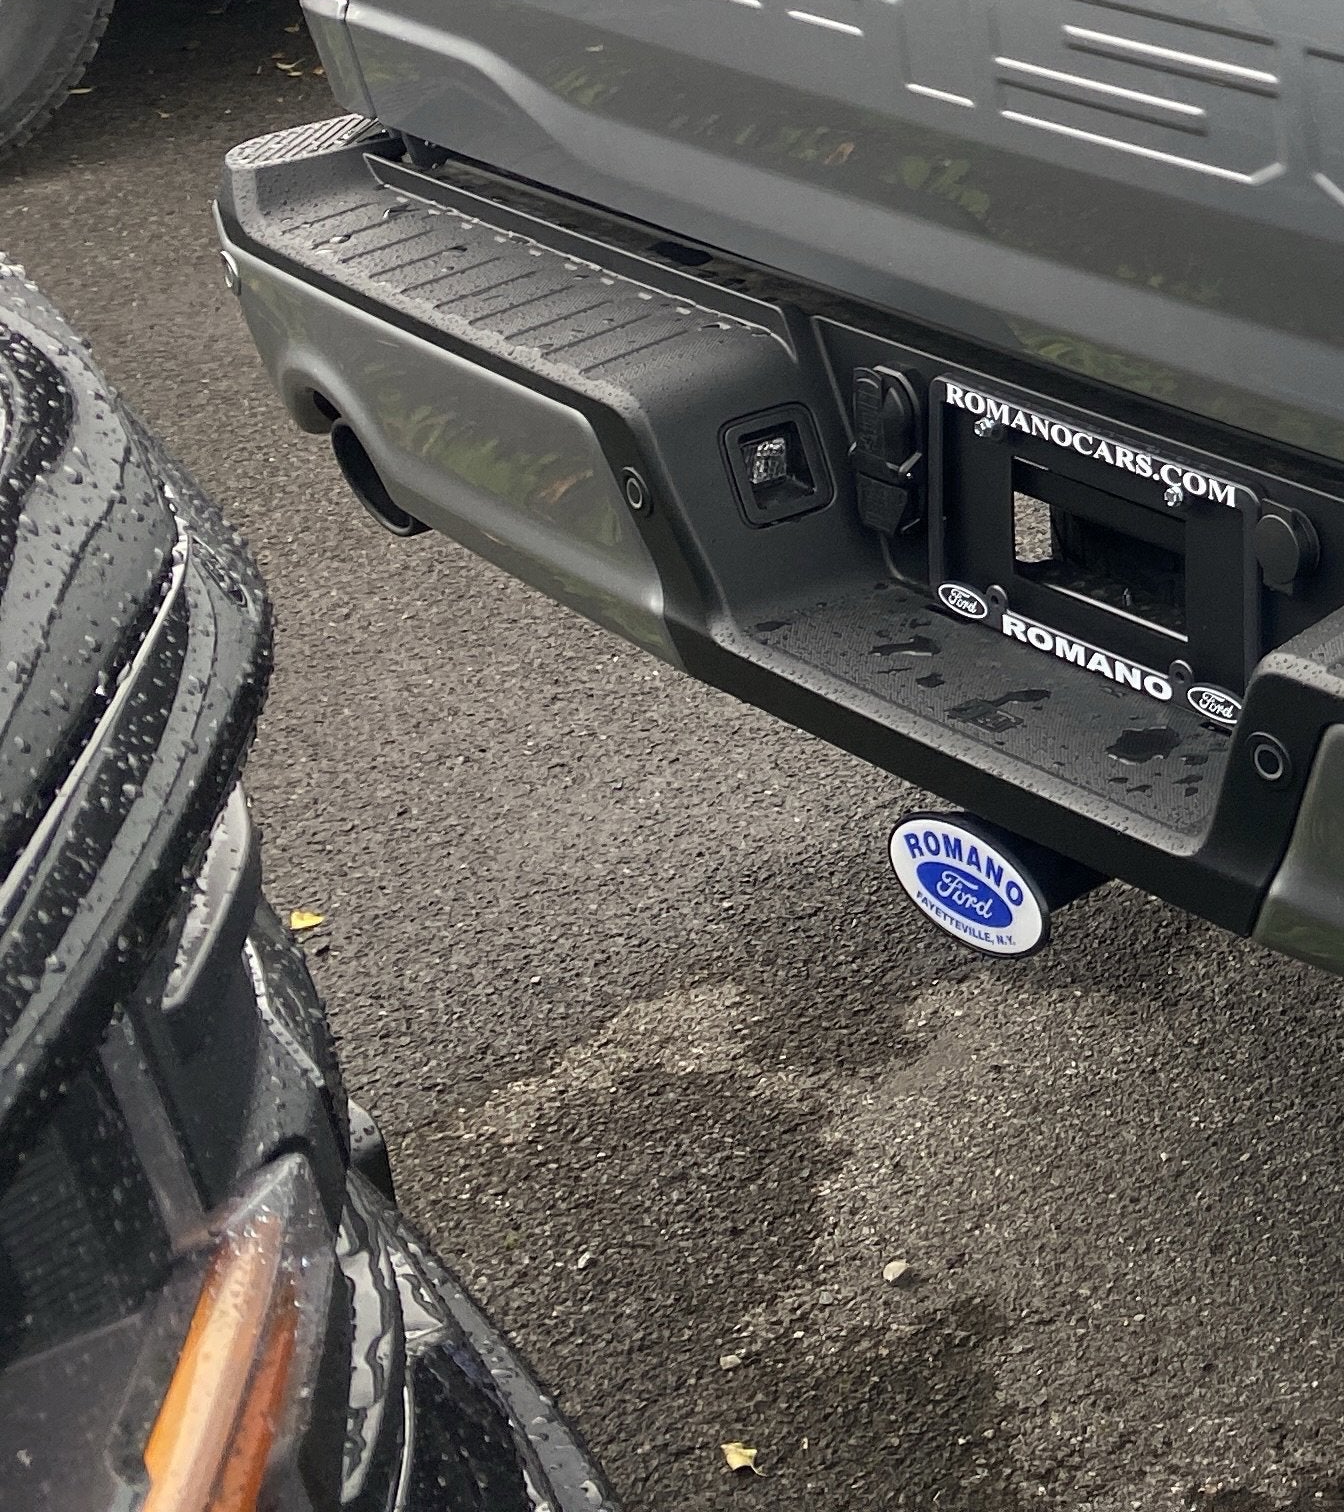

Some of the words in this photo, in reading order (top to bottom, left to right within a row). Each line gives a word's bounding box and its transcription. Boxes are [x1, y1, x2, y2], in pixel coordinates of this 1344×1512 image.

[945, 382, 1236, 508] ROMANOCARS.COM
[948, 588, 978, 614] Ford
[1001, 613, 1174, 702] ROMANO
[1198, 691, 1233, 719] Ford
[903, 830, 1025, 908] ROMANO
[936, 870, 993, 919] Ford
[916, 890, 995, 945] FAYETTEVILLE,
